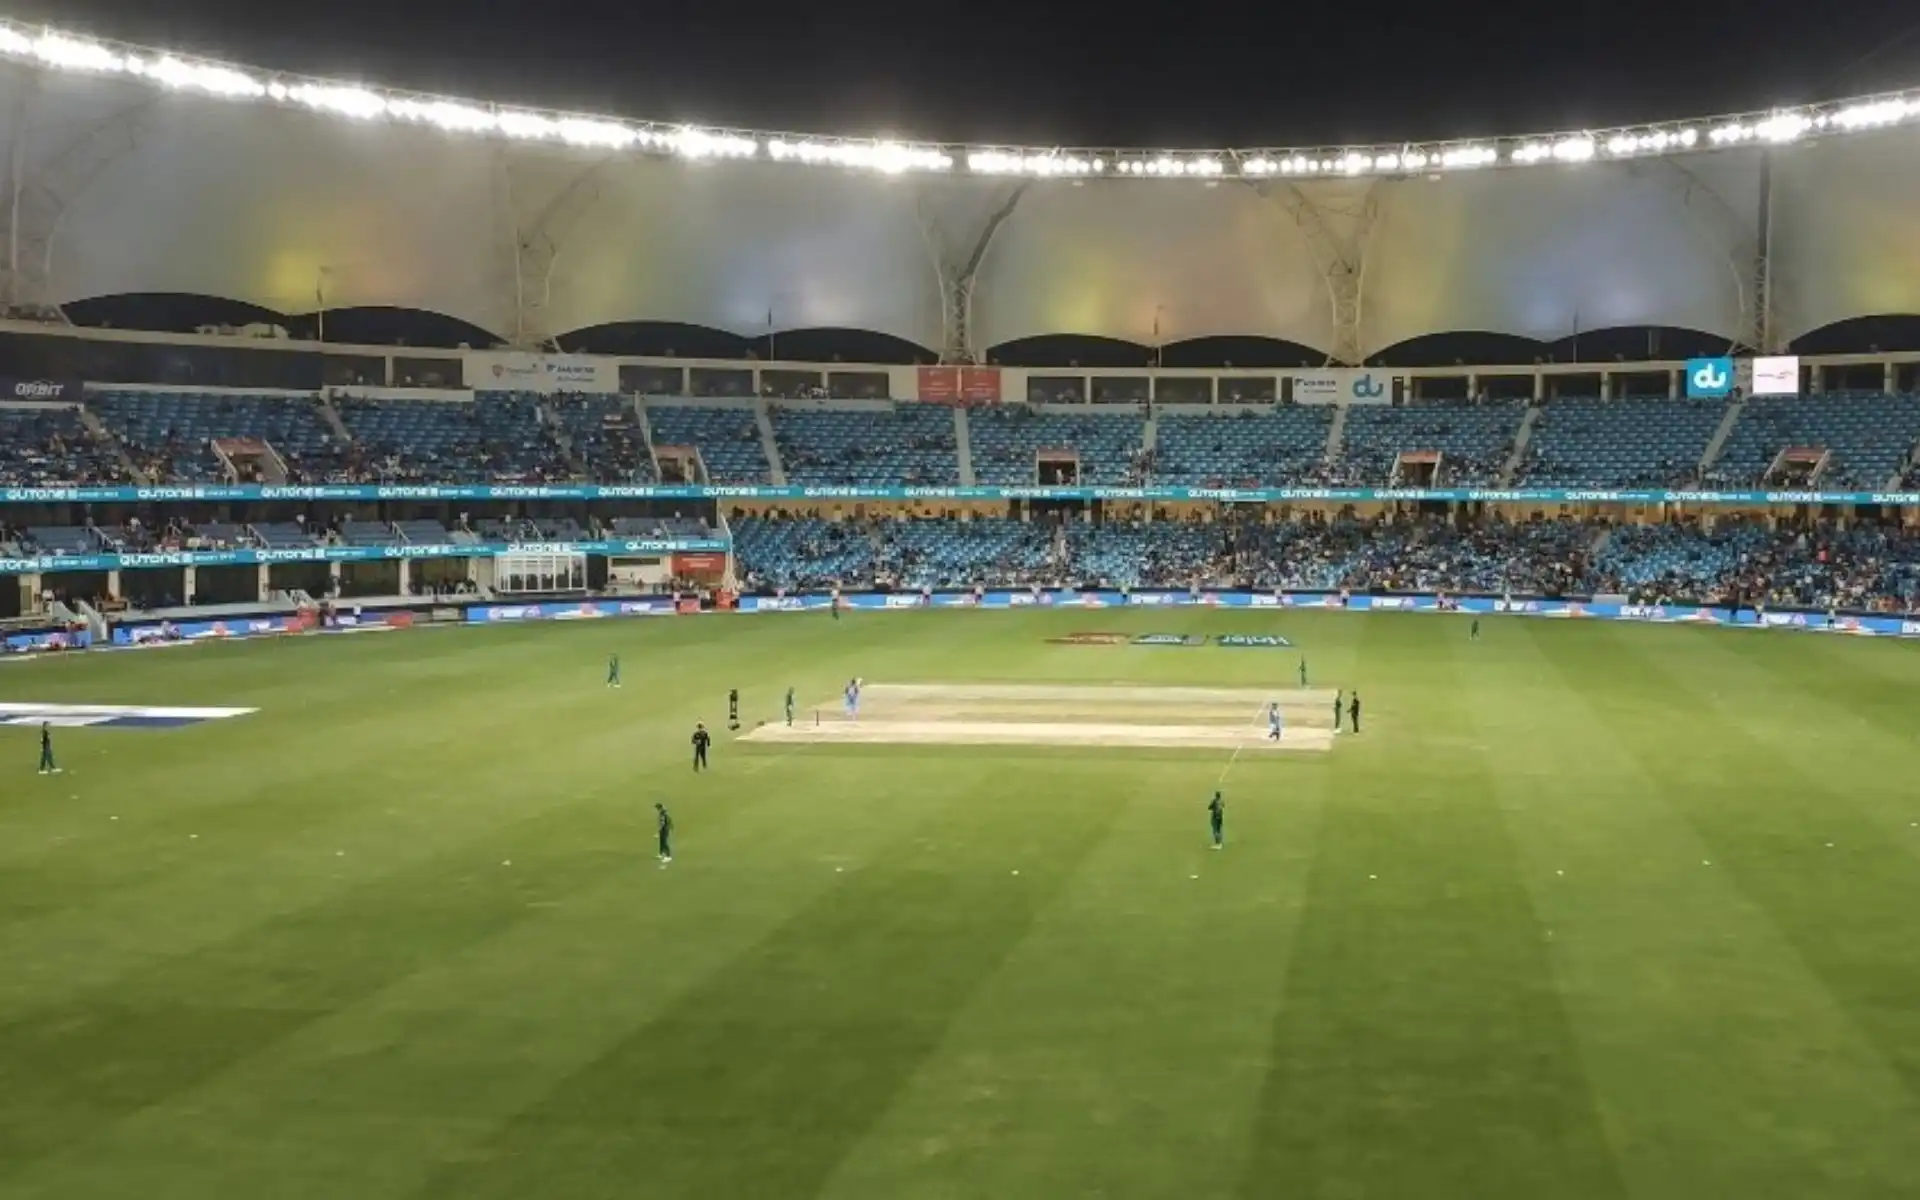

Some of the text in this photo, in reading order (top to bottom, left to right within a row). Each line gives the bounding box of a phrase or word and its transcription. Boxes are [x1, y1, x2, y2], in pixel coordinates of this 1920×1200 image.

[1352, 373, 1384, 398] du
[1693, 363, 1727, 389] du
[0, 558, 39, 570] TONE
